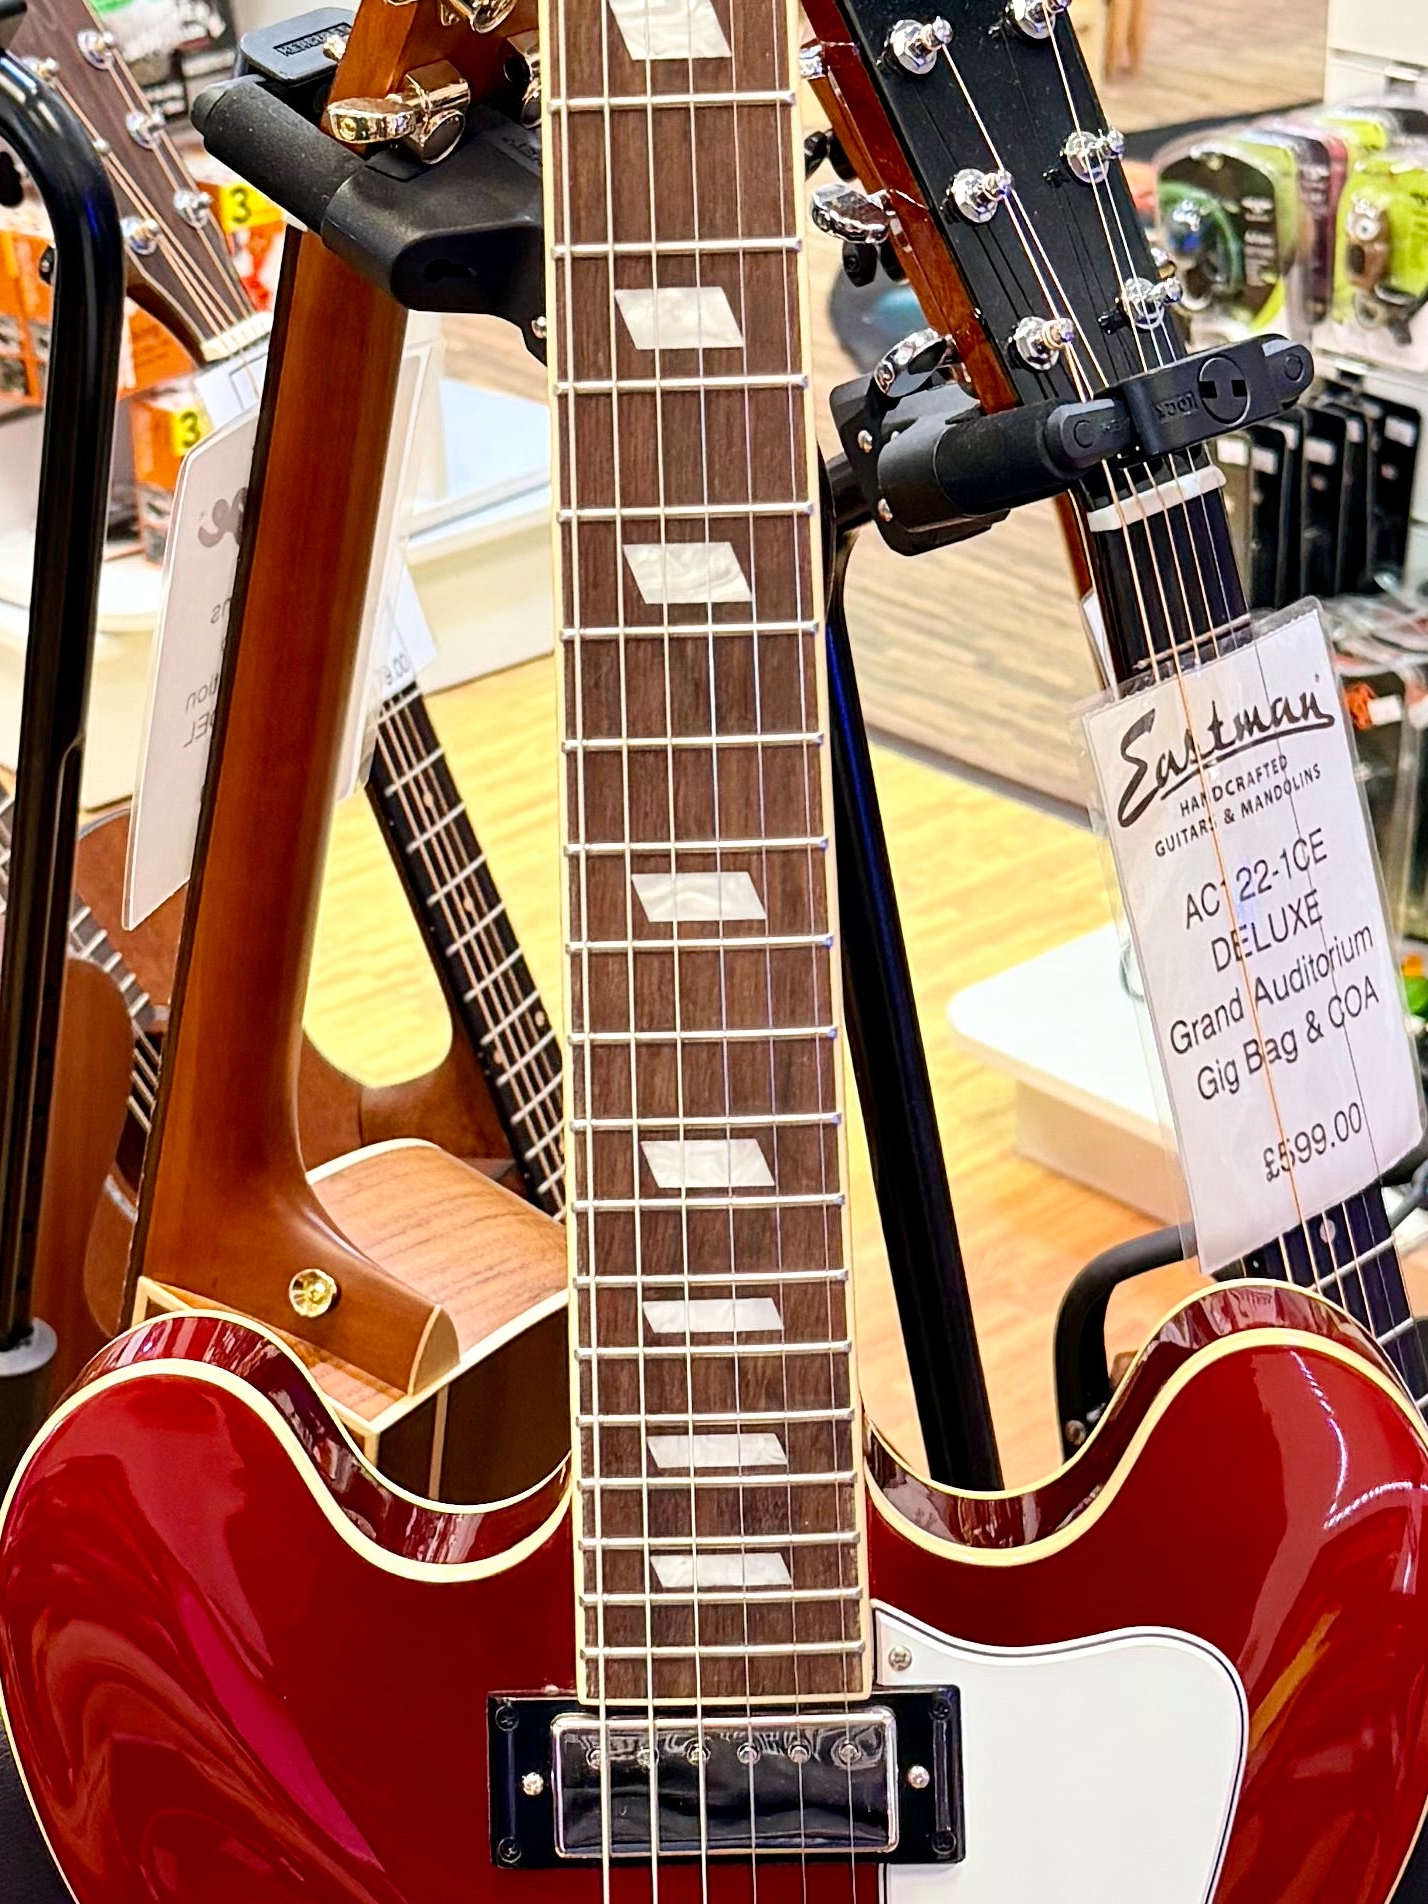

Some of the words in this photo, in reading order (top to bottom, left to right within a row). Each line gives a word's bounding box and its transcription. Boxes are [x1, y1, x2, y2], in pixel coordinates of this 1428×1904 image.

[231, 184, 254, 226] 3
[180, 411, 202, 452] 3
[1118, 691, 1335, 829] Eastman
[1180, 754, 1288, 818] HANDCRAFTED
[1155, 817, 1217, 858] GUITARS
[1223, 807, 1236, 825] &
[1240, 762, 1322, 819] MANDOLINS
[1185, 827, 1328, 930] AC22-1CE
[1211, 888, 1323, 974] DELUXE
[1170, 987, 1245, 1056] Grand
[1254, 925, 1375, 1010] Auditorium
[1197, 1058, 1241, 1100] Gig
[1243, 1029, 1299, 1076] Bag
[1305, 1009, 1325, 1045] &
[1328, 975, 1380, 1029] COA
[1263, 1101, 1363, 1183] £599.00
